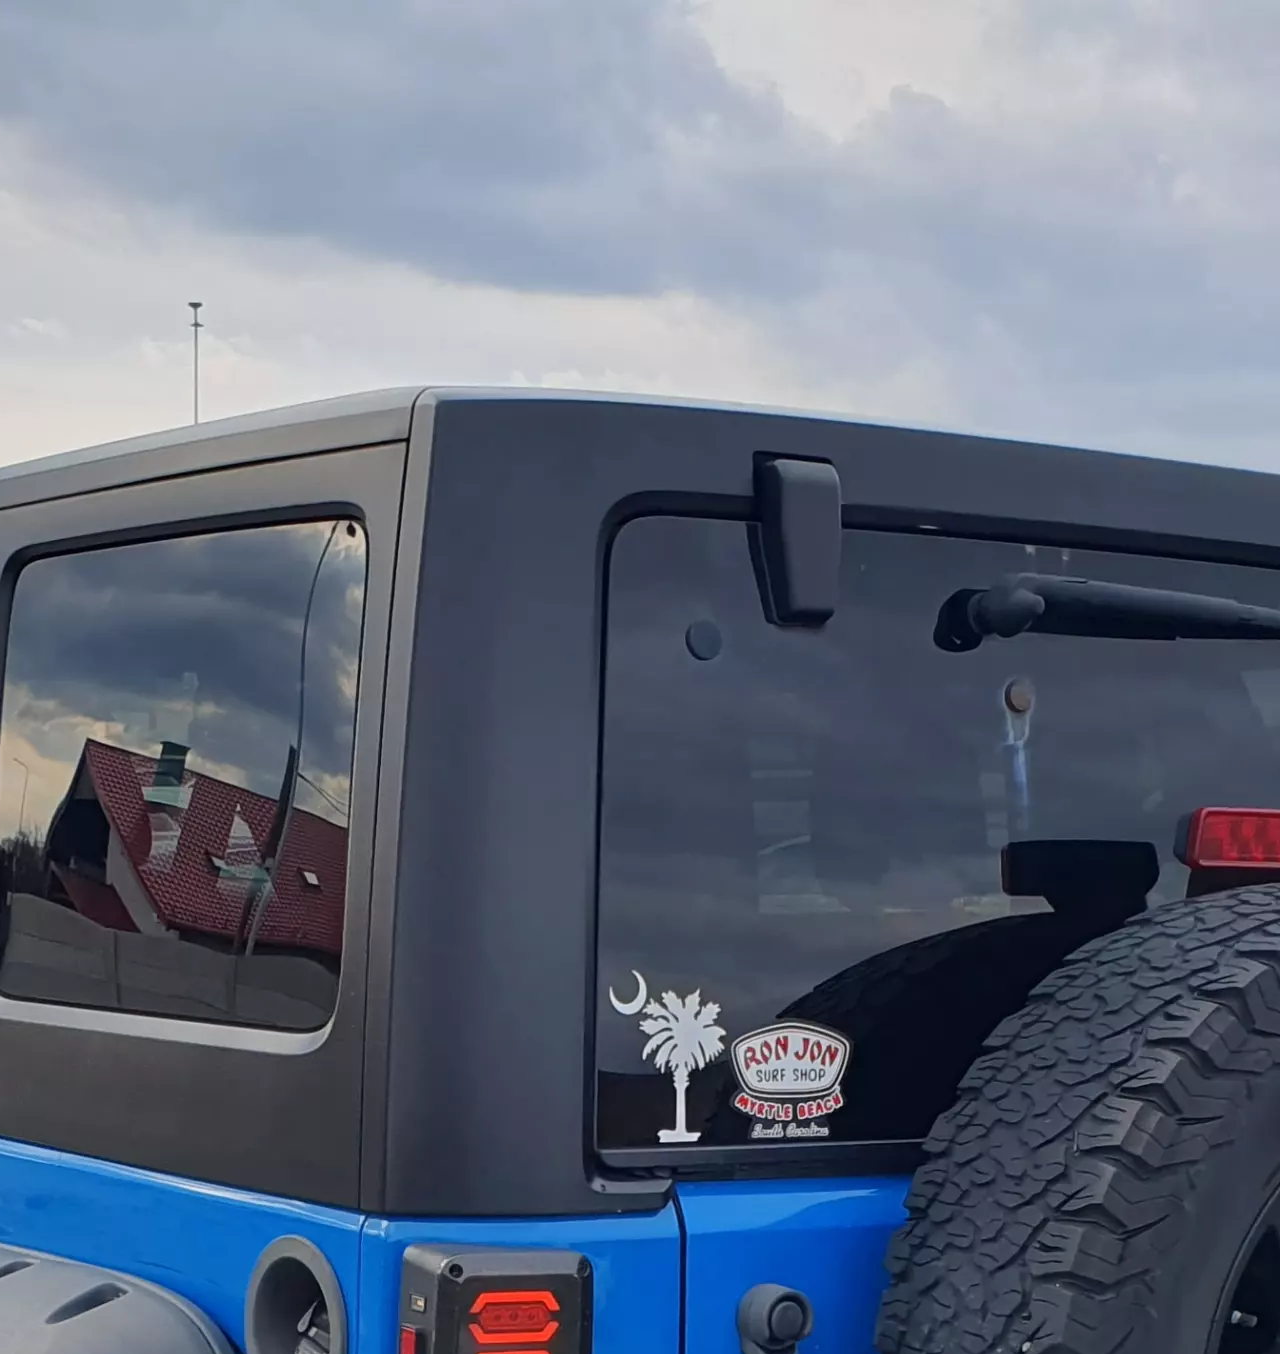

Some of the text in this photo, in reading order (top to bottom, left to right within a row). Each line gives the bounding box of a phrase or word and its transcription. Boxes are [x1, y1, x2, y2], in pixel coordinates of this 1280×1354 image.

[744, 1036, 839, 1071] RON JON
[756, 1068, 826, 1083] SURF SHOP
[735, 1091, 843, 1120] MYRTLE BEACH
